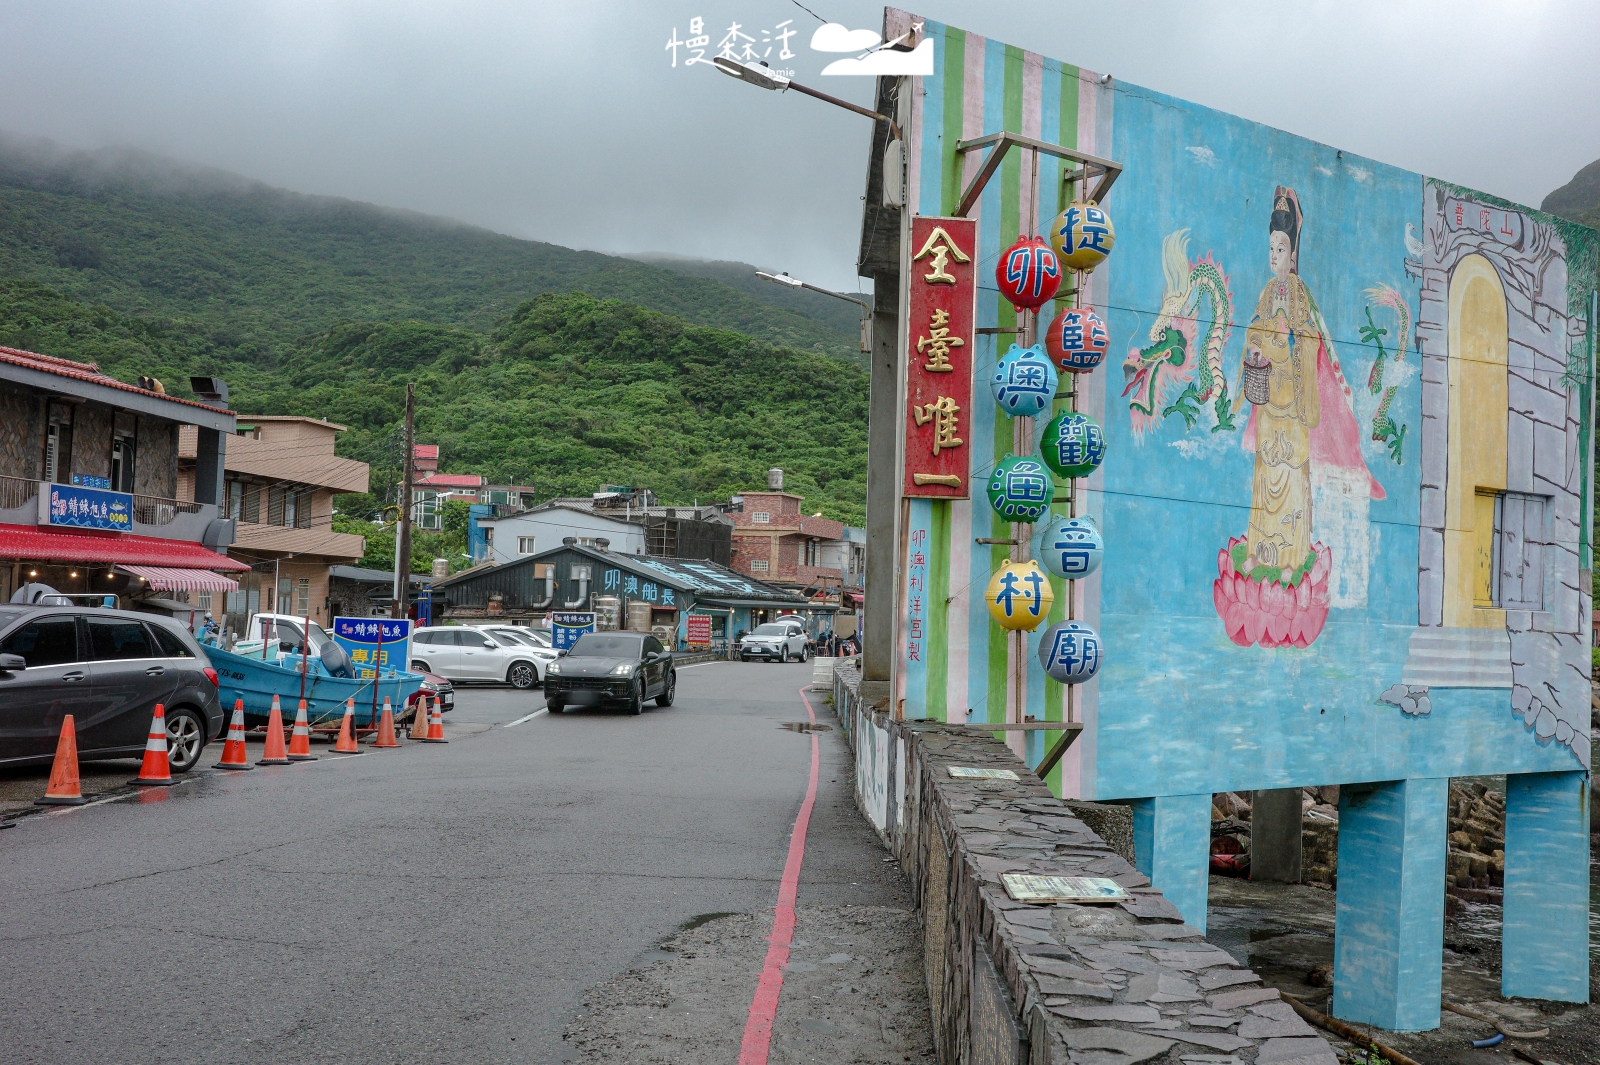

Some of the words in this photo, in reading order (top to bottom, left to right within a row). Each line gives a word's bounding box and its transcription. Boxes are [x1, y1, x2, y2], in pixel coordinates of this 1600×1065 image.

[1455, 203, 1514, 238] 普陀山
[913, 227, 971, 488] 全臺唯一
[604, 568, 675, 606] 卯澳船長
[908, 529, 926, 662] 卯澳利洋宮製
[351, 648, 389, 666] 專用
